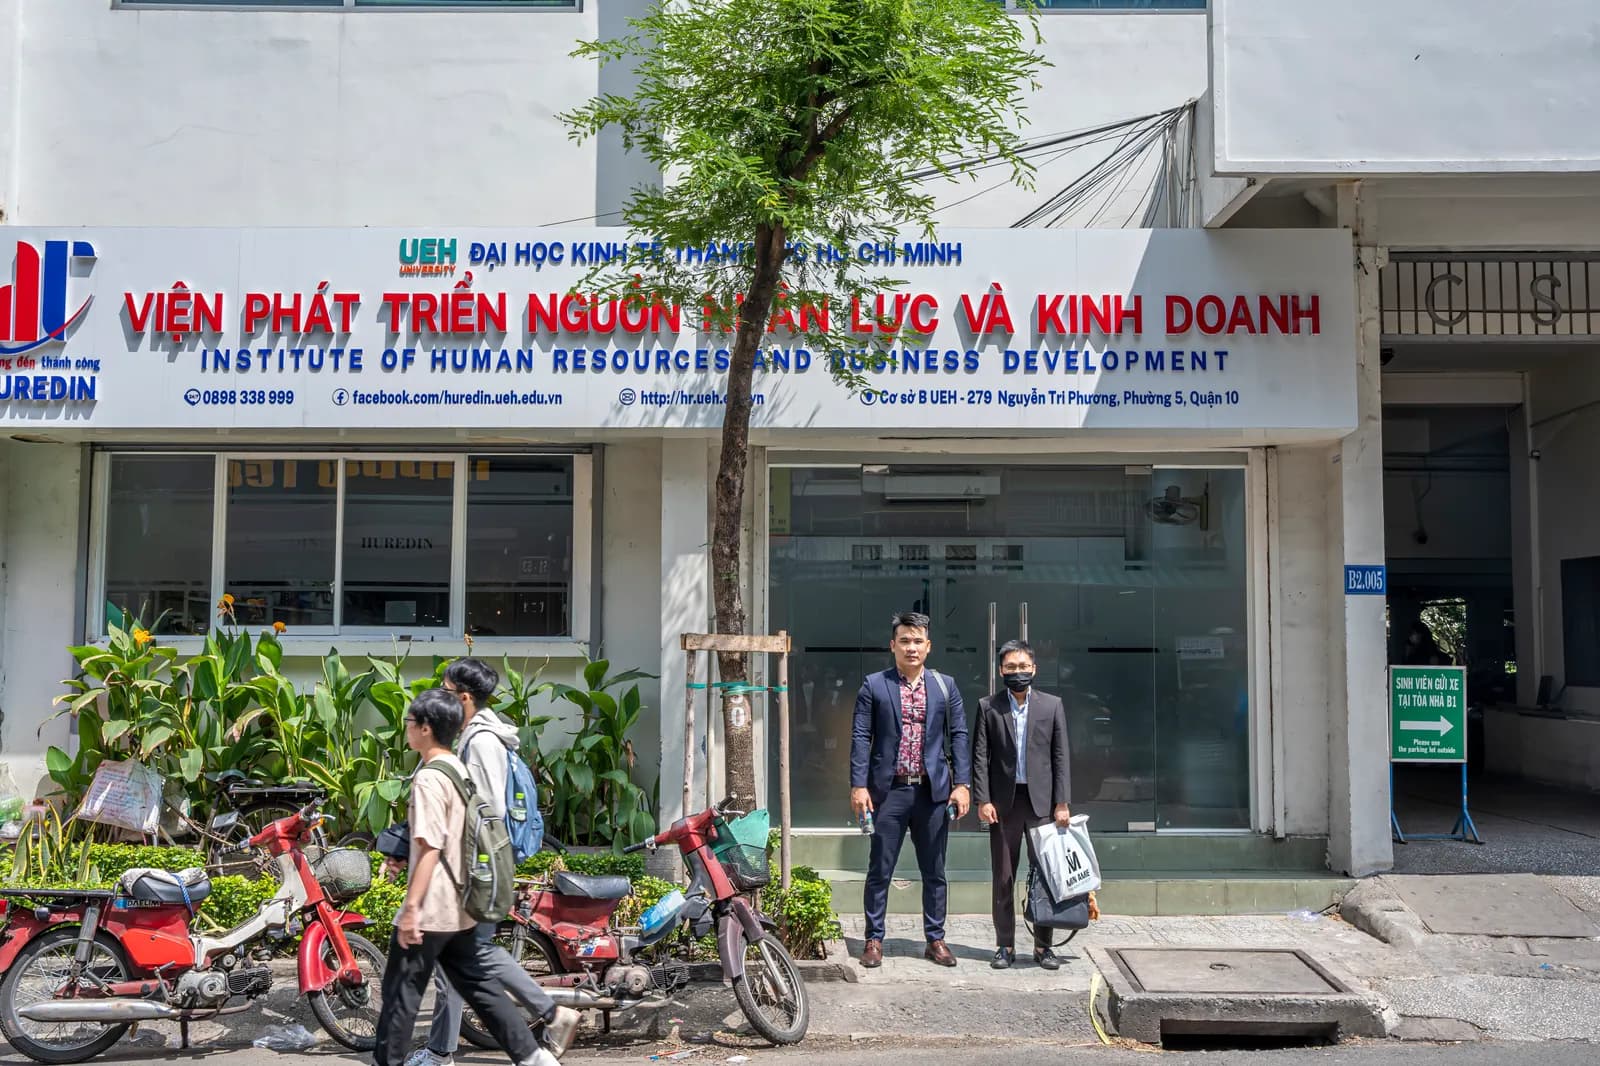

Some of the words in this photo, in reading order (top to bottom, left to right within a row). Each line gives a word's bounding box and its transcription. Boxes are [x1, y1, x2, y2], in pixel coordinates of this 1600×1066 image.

[400, 239, 457, 263] UEH
[469, 242, 507, 270] ĐẠI
[515, 241, 565, 270] HỌC
[571, 242, 628, 262] KINH
[858, 236, 896, 263] CHÍ
[903, 242, 963, 263] MINH
[400, 265, 456, 275] UNIVERSITY
[125, 280, 223, 342] VIỆN
[245, 280, 360, 333] PHÁT
[383, 271, 507, 333] TRIỂN
[703, 281, 829, 333] NÂN
[851, 293, 939, 342] LỰC
[961, 282, 1014, 335] VÀ
[1038, 294, 1142, 335] KINH
[1166, 296, 1320, 335] DOANH
[201, 348, 364, 370] INSTITUTE
[381, 348, 416, 370] OF
[431, 348, 534, 370] HUMAN
[553, 349, 730, 371] RESOURCES
[753, 349, 812, 371] AND
[831, 349, 980, 371] BUSINESS
[1003, 350, 1228, 371] DEVELOPMENT
[203, 390, 237, 405] 0898
[240, 390, 266, 405] 338
[268, 390, 295, 405] 999
[353, 389, 563, 405] facebook.com/huredin.ueh.edu.vn
[641, 390, 765, 407] http://hr.ueh.evn
[879, 390, 898, 404] Cơ
[900, 388, 916, 404] sở
[918, 390, 928, 404] B
[930, 390, 957, 404] UEH
[967, 390, 993, 405] 279
[998, 387, 1046, 408] Nguyễn
[1048, 390, 1066, 405] Tri
[1068, 390, 1121, 408] Phương,
[1123, 391, 1172, 408] Phường
[1174, 391, 1187, 407] 5,
[1189, 390, 1223, 408] Quận
[1225, 391, 1239, 405] 10
[361, 536, 433, 550] HUREDIN
[1348, 569, 1383, 590] B2.005
[1396, 677, 1414, 690] SINH
[1415, 674, 1433, 691] VIÊN
[1435, 673, 1448, 691] GỬI
[1449, 678, 1460, 691] XE
[1398, 694, 1411, 710] TẠI
[1412, 691, 1428, 708] TÒA
[1429, 692, 1445, 708] NHÀ
[1446, 695, 1457, 708] B1
